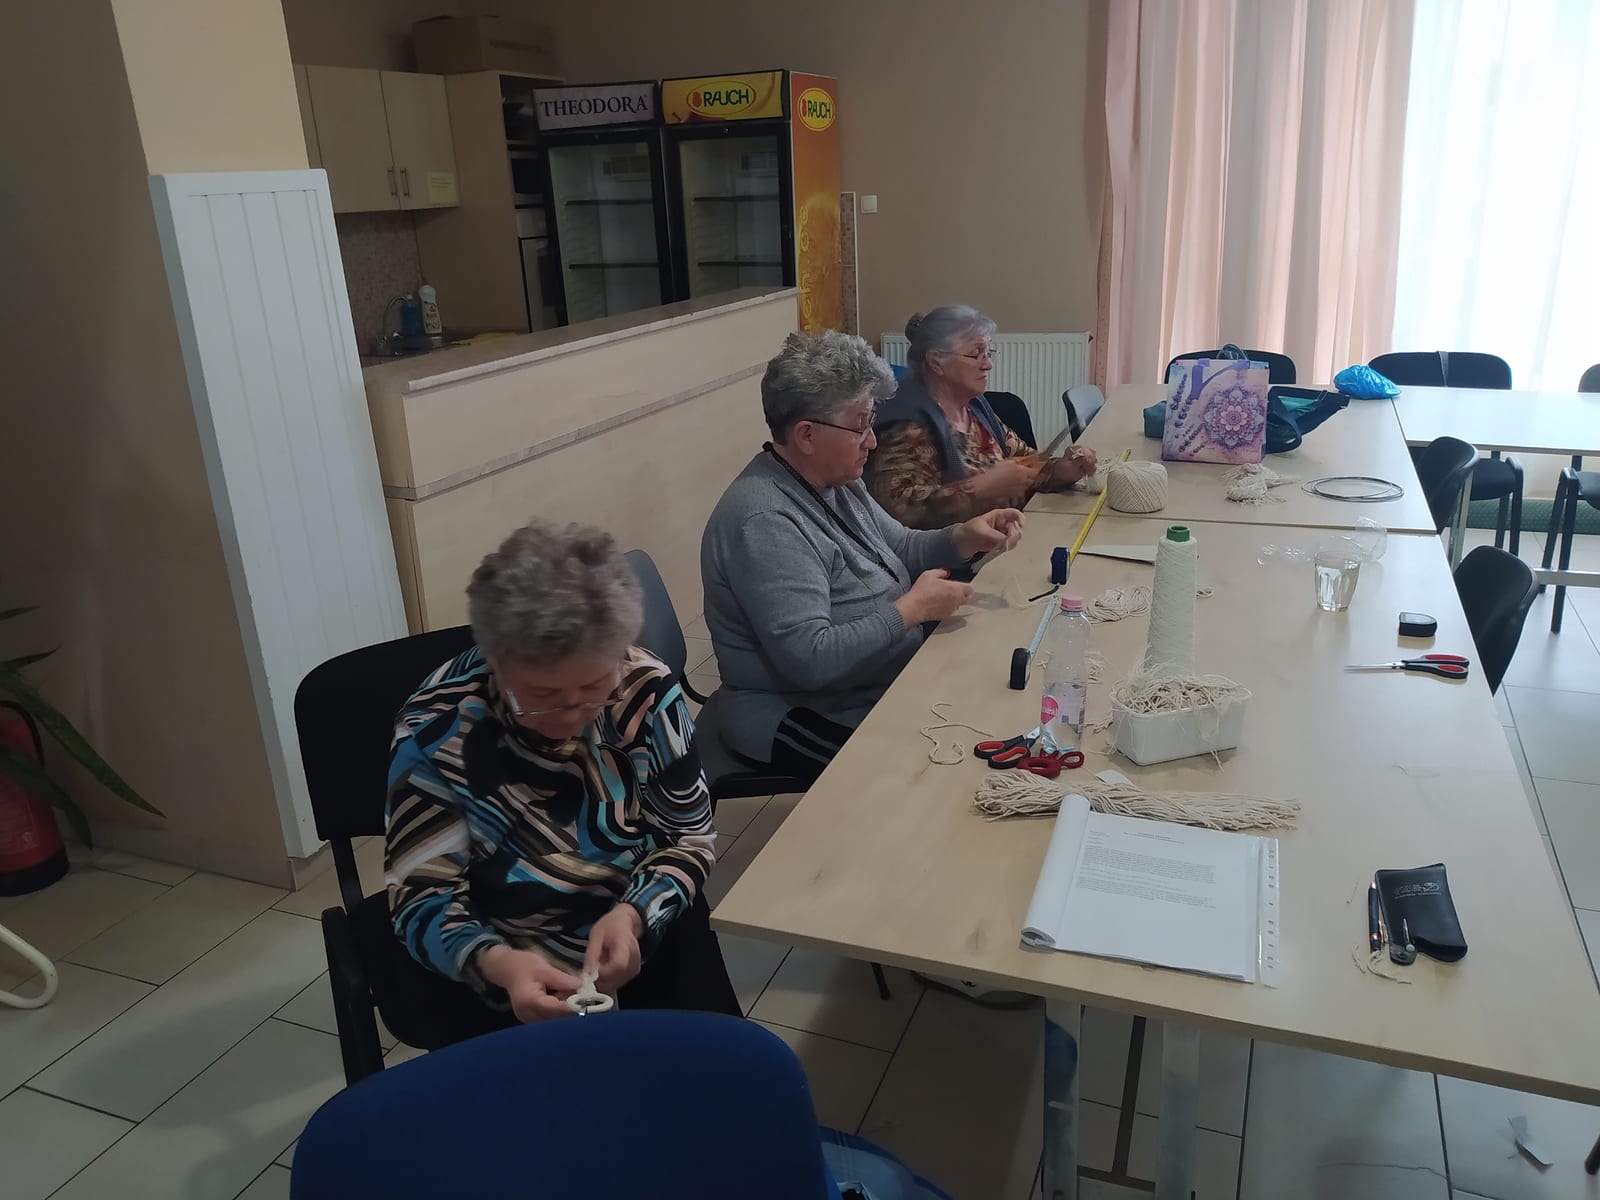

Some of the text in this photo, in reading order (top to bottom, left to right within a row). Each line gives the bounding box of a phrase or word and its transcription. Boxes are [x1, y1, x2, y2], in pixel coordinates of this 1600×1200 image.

[541, 95, 648, 117] THEODORA
[703, 88, 749, 107] RAUCH
[807, 100, 831, 119] RAUCH
